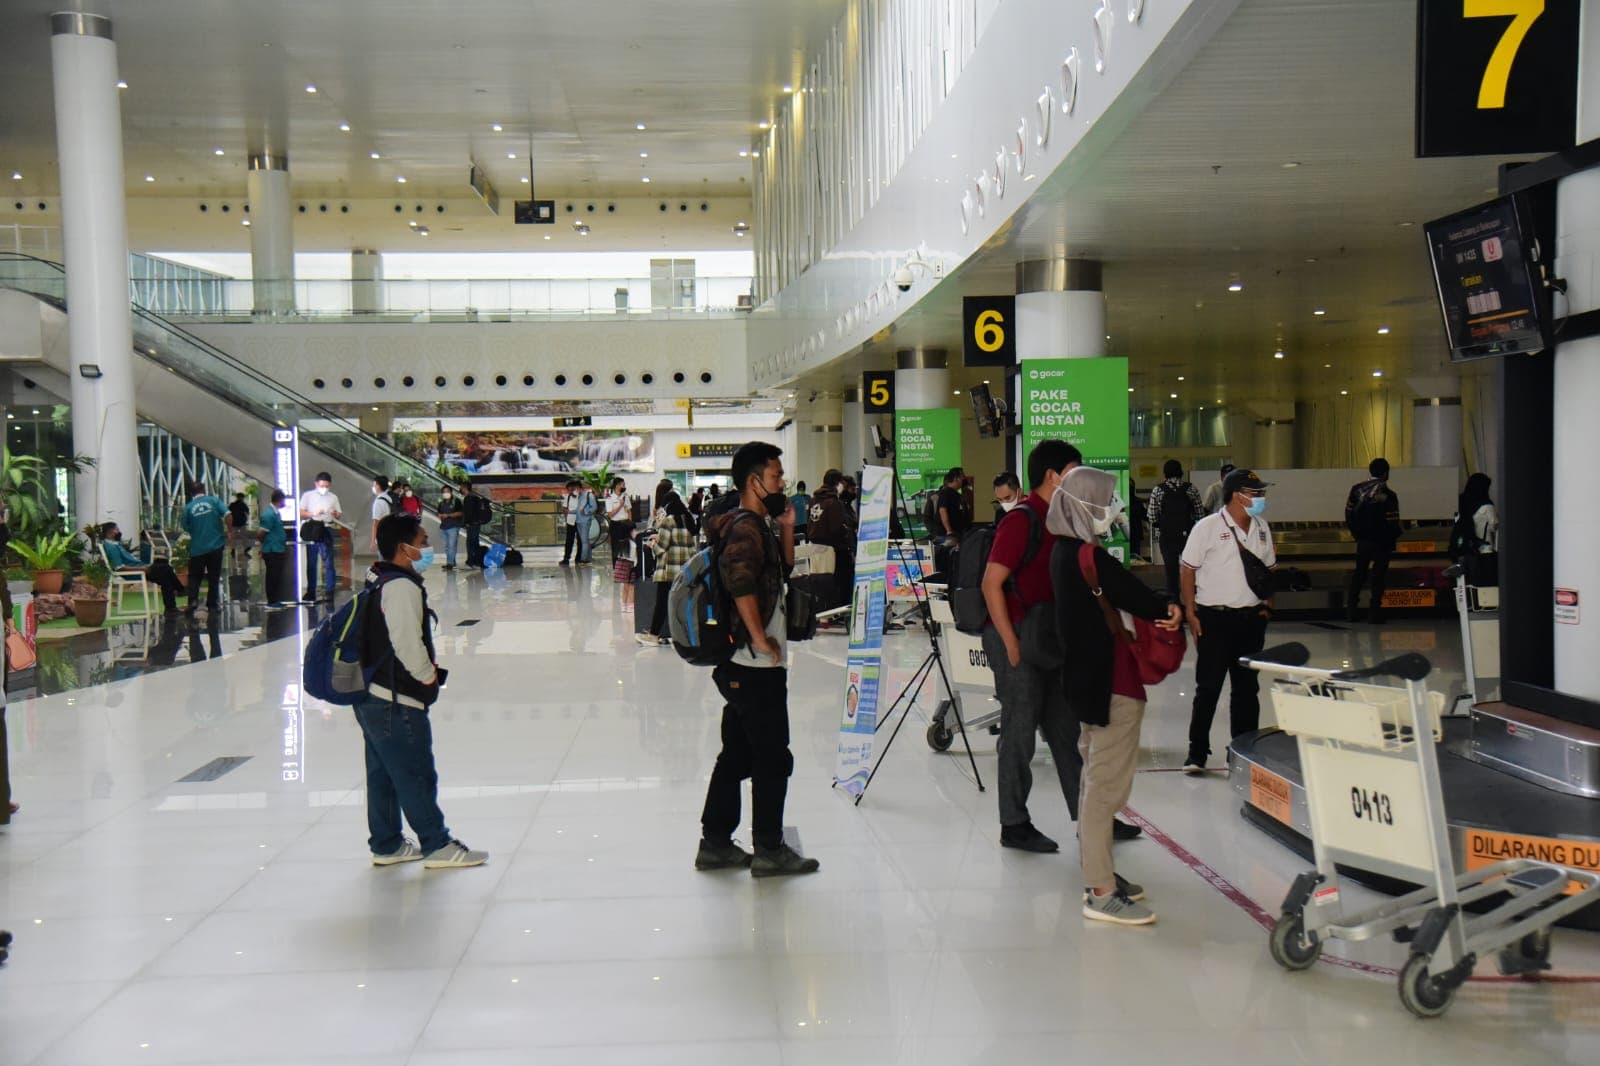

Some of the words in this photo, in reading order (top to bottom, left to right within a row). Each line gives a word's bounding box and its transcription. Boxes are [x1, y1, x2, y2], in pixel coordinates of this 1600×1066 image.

[1462, 0, 1545, 109] 7
[974, 310, 1005, 352] 6
[1040, 370, 1065, 379] gocar
[870, 379, 890, 406] 5
[1030, 389, 1068, 400] PAKE
[1030, 402, 1081, 413] GOCAR
[1030, 414, 1085, 426] INSTAN
[969, 649, 990, 667] 080
[1351, 786, 1393, 826] 0413
[1472, 835, 1566, 864] DILARANG
